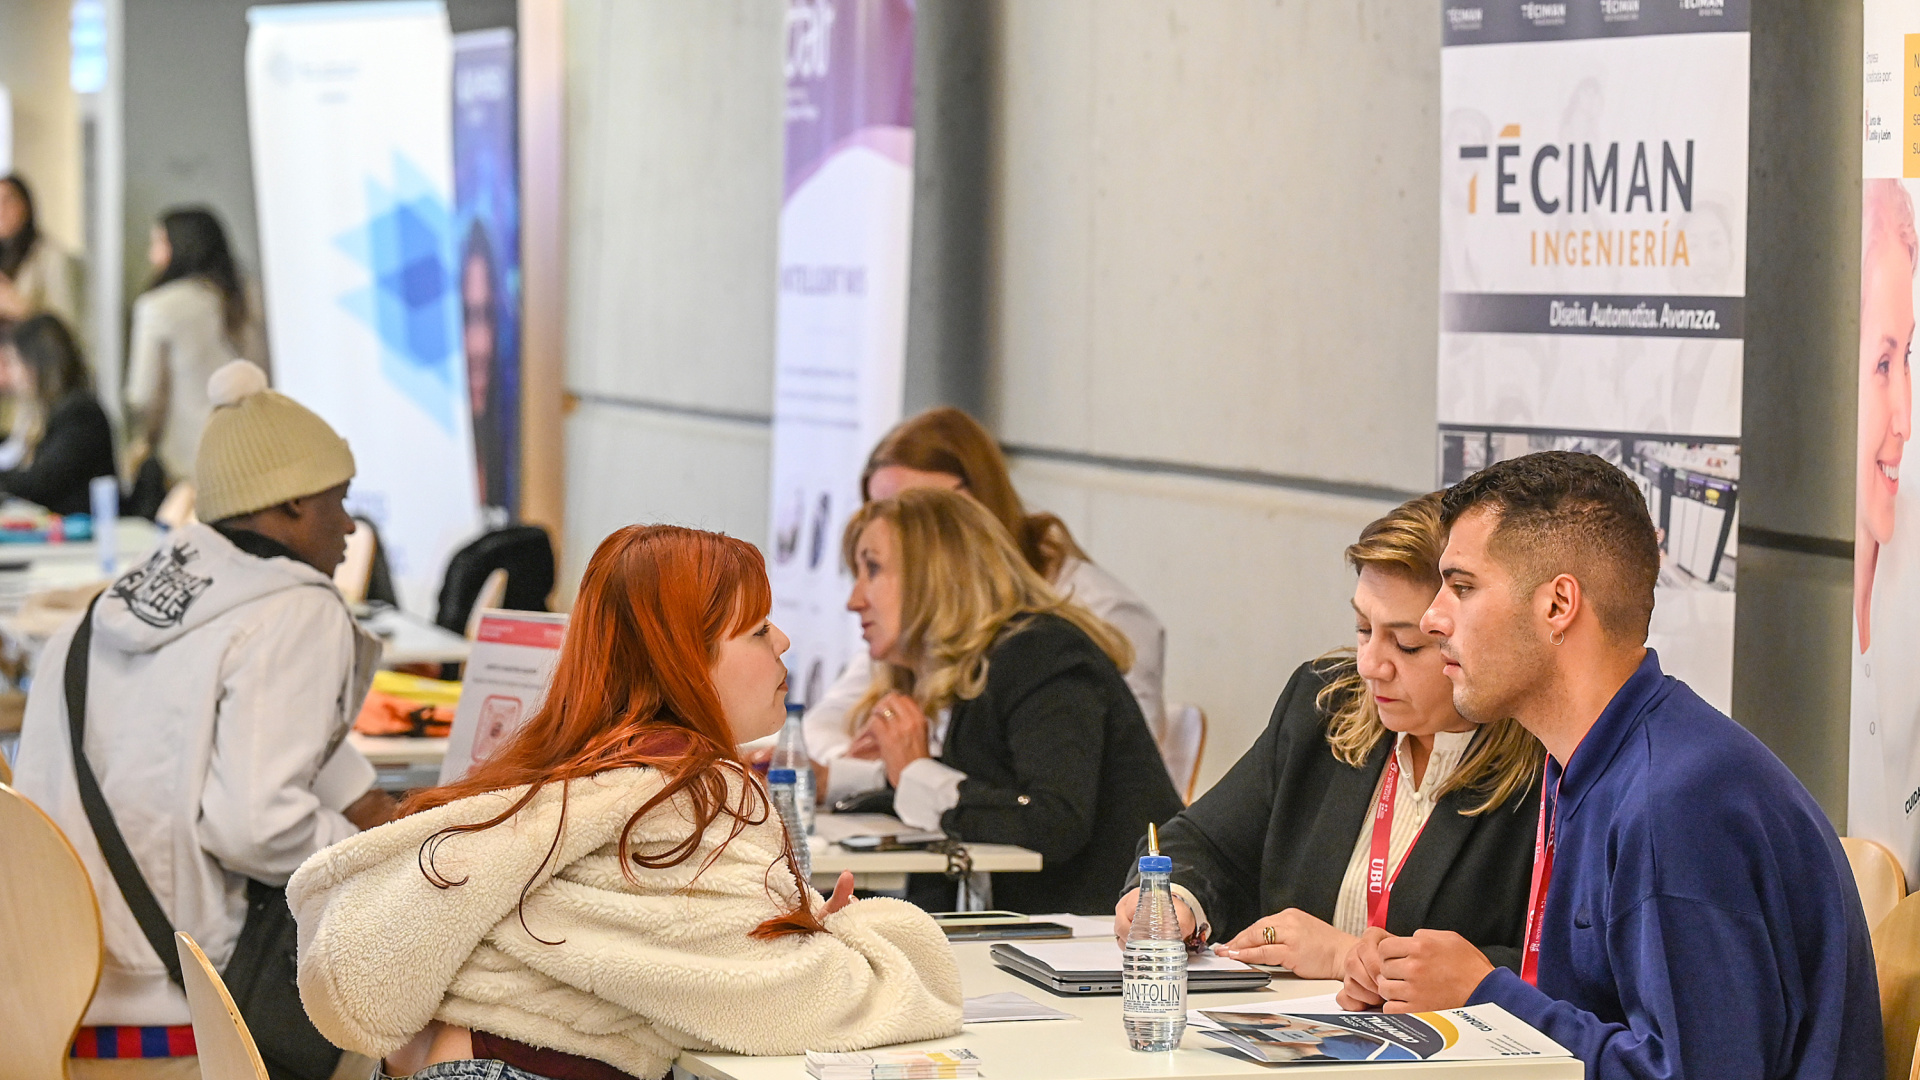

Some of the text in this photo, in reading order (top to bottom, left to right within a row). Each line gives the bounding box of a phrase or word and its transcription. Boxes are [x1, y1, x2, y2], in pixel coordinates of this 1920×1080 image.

[1881, 129, 1891, 141] León
[1459, 124, 1694, 214] TÉCIMAN
[1531, 219, 1690, 267] INGENIERÍA
[1660, 302, 1721, 331] Avanza.
[1369, 858, 1385, 894] UBU
